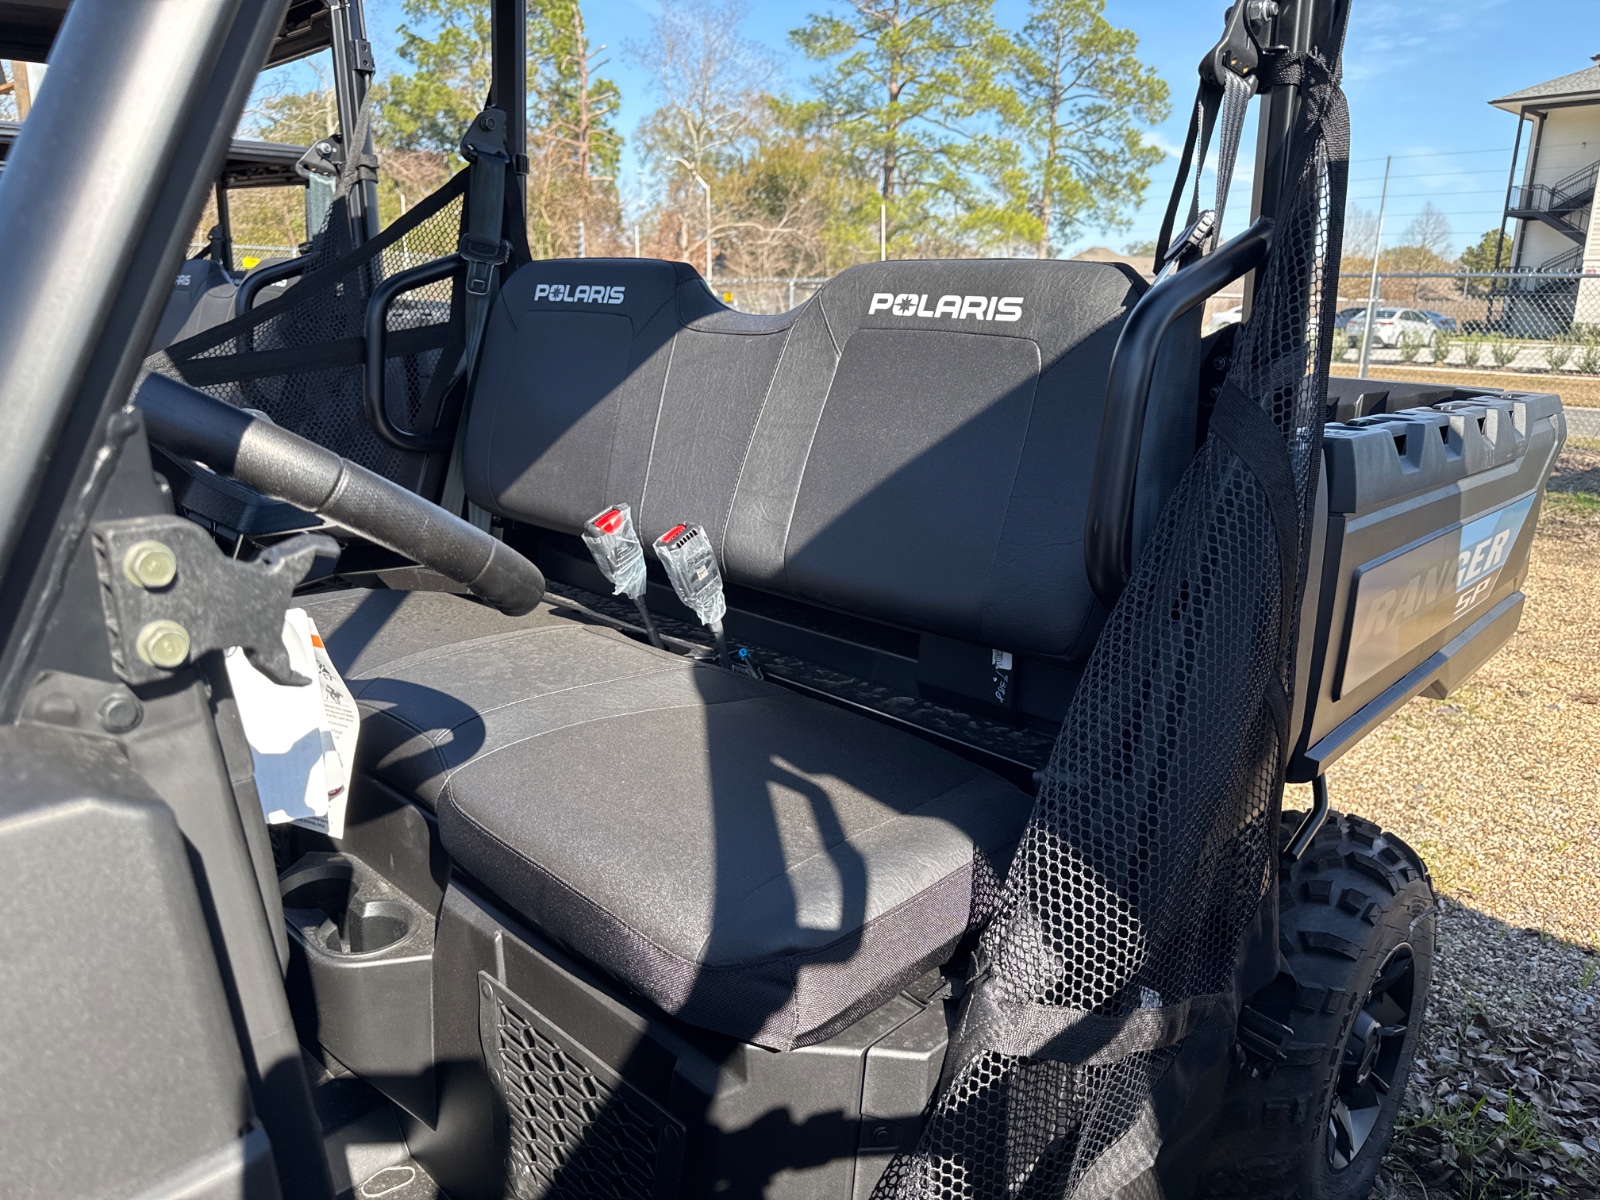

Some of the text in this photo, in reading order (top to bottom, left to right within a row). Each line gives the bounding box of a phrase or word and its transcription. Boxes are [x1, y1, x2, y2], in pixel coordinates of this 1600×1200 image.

[534, 284, 626, 305] POLARIS
[868, 292, 1024, 322] POLARIS
[1356, 529, 1511, 646] RANGER
[1453, 577, 1492, 616] SP
